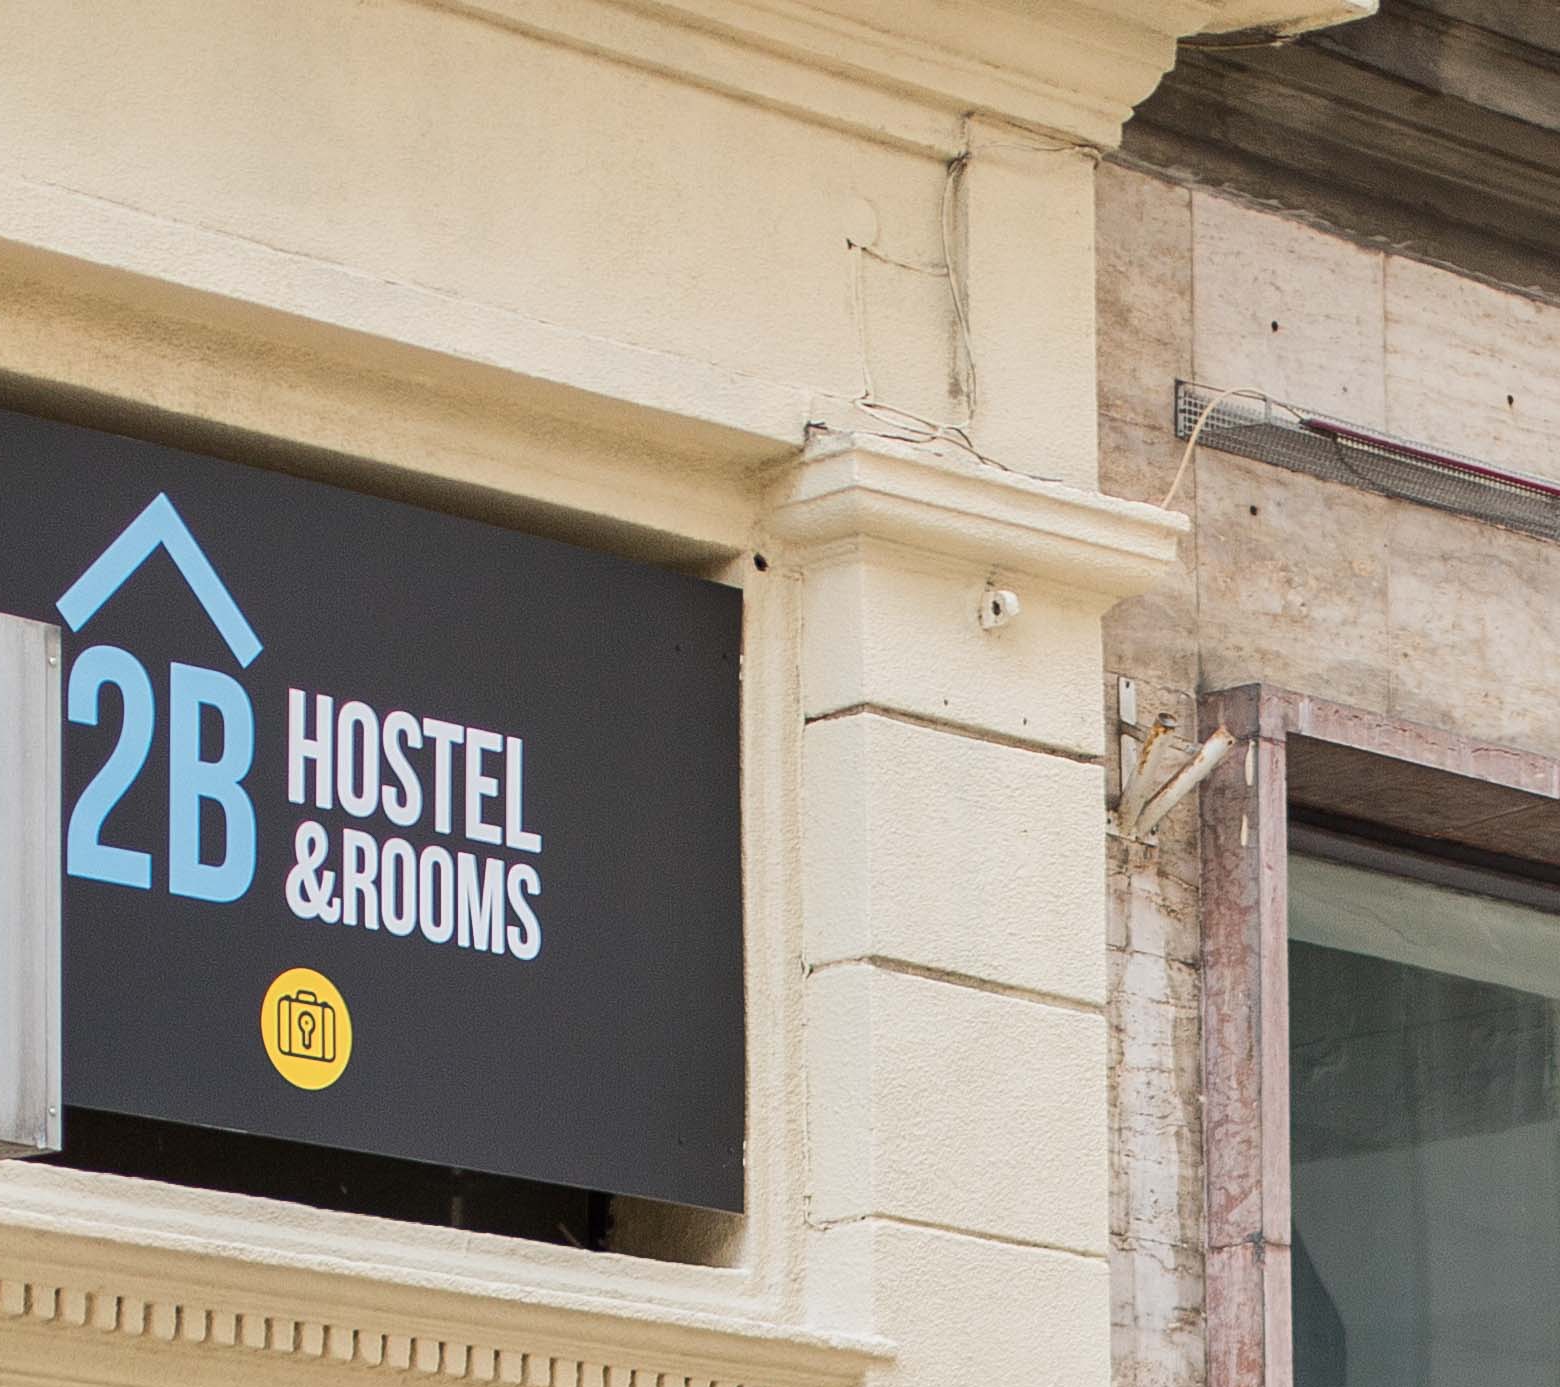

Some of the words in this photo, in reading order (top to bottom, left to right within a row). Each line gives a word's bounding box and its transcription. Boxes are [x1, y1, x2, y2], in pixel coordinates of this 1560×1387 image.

[66, 644, 258, 904] 2B
[287, 688, 544, 853] HOSTEL
[285, 819, 543, 962] &ROOMS
